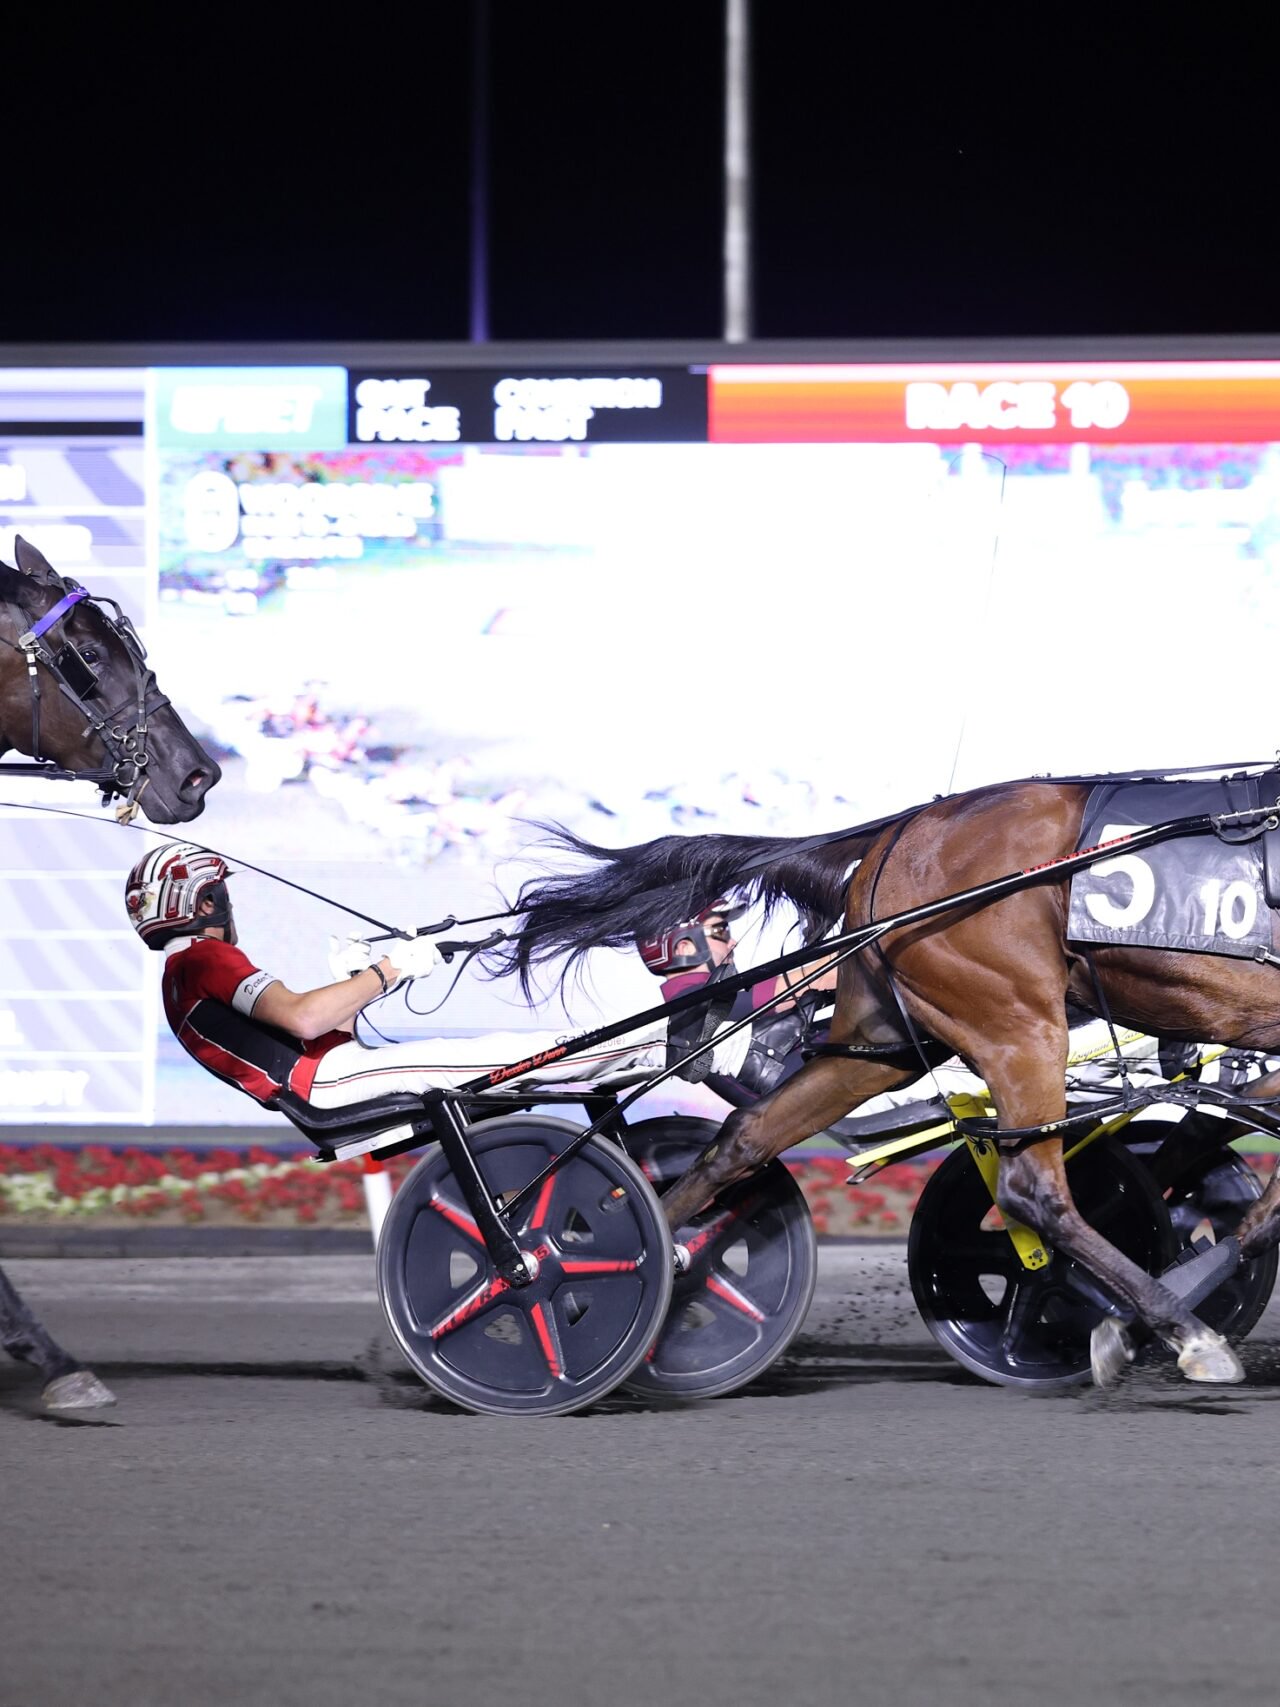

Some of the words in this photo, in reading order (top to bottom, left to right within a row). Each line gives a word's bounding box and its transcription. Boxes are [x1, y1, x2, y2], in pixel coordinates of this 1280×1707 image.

[904, 382, 1056, 430] RACE
[1061, 381, 1130, 430] 10
[1085, 824, 1155, 929] 5
[1200, 878, 1258, 940] 10
